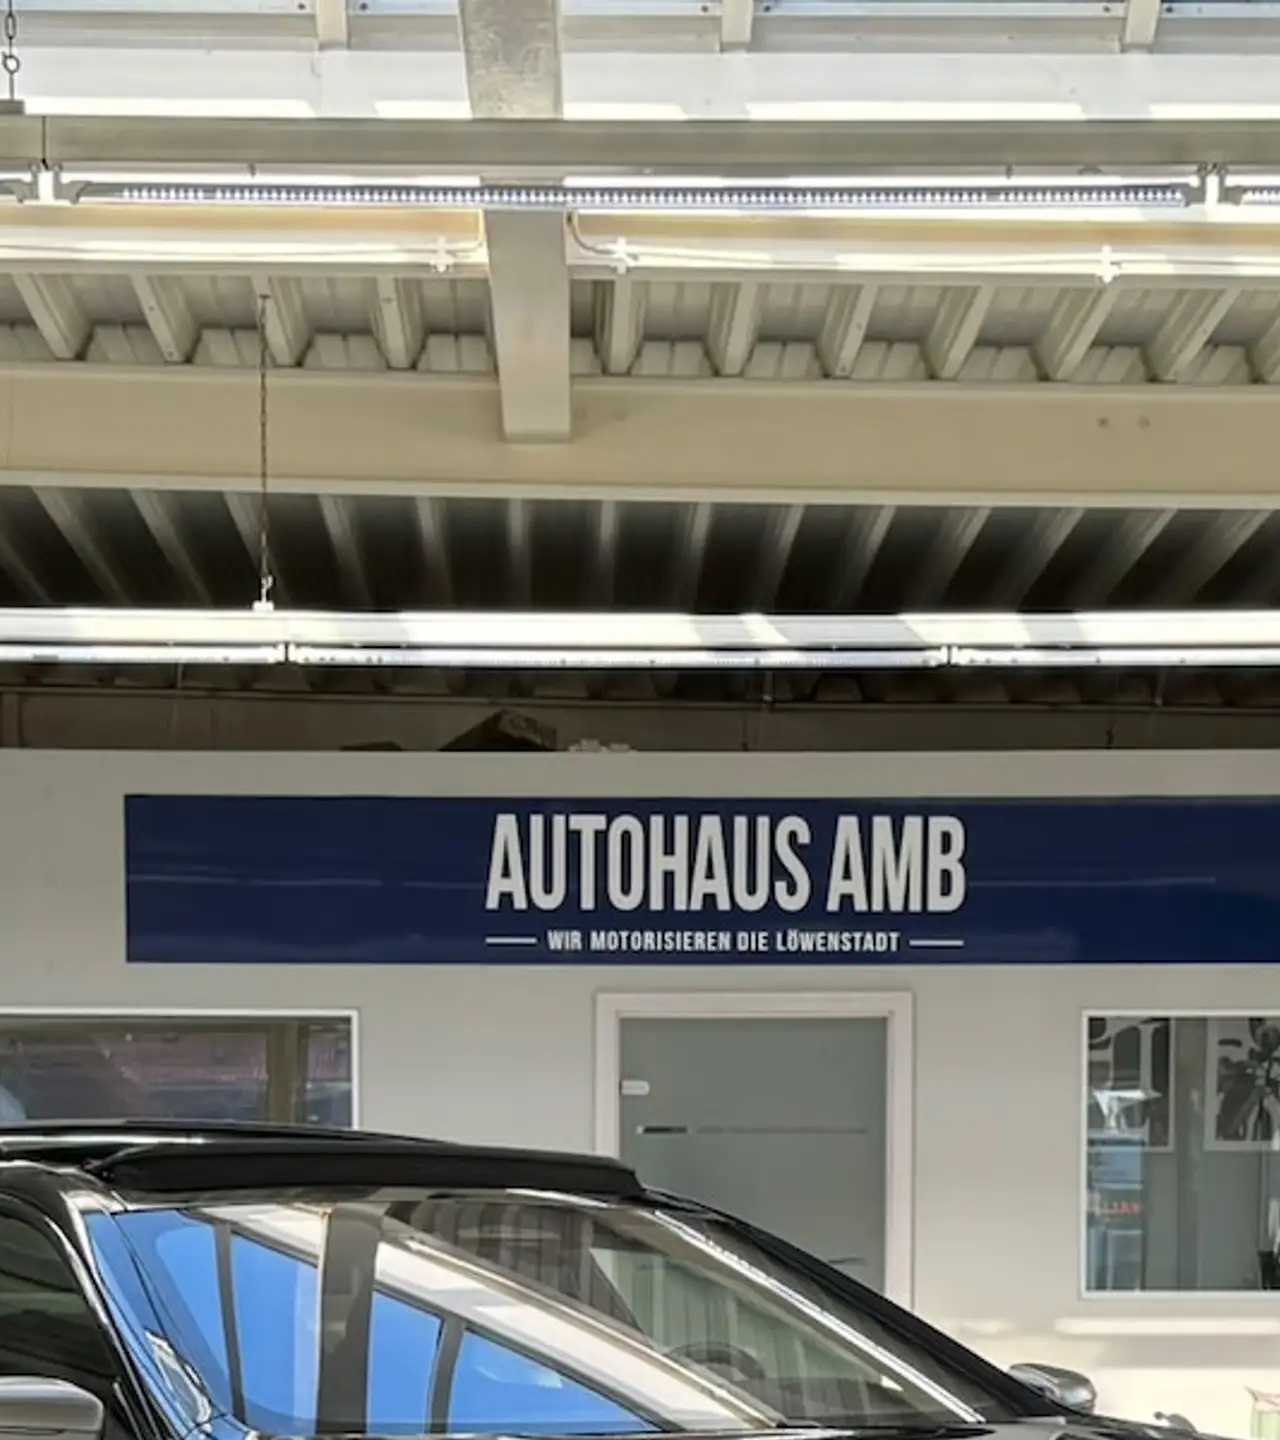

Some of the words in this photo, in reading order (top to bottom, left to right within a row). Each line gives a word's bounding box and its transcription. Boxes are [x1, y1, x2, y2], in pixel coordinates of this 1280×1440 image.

[485, 814, 811, 911] AUTOHAUS
[826, 815, 966, 912] AMB
[547, 930, 582, 950] WIR
[590, 930, 730, 951] MOTORISIEREN
[736, 931, 769, 951] DIE
[776, 928, 901, 952] LÖWENSTADT
